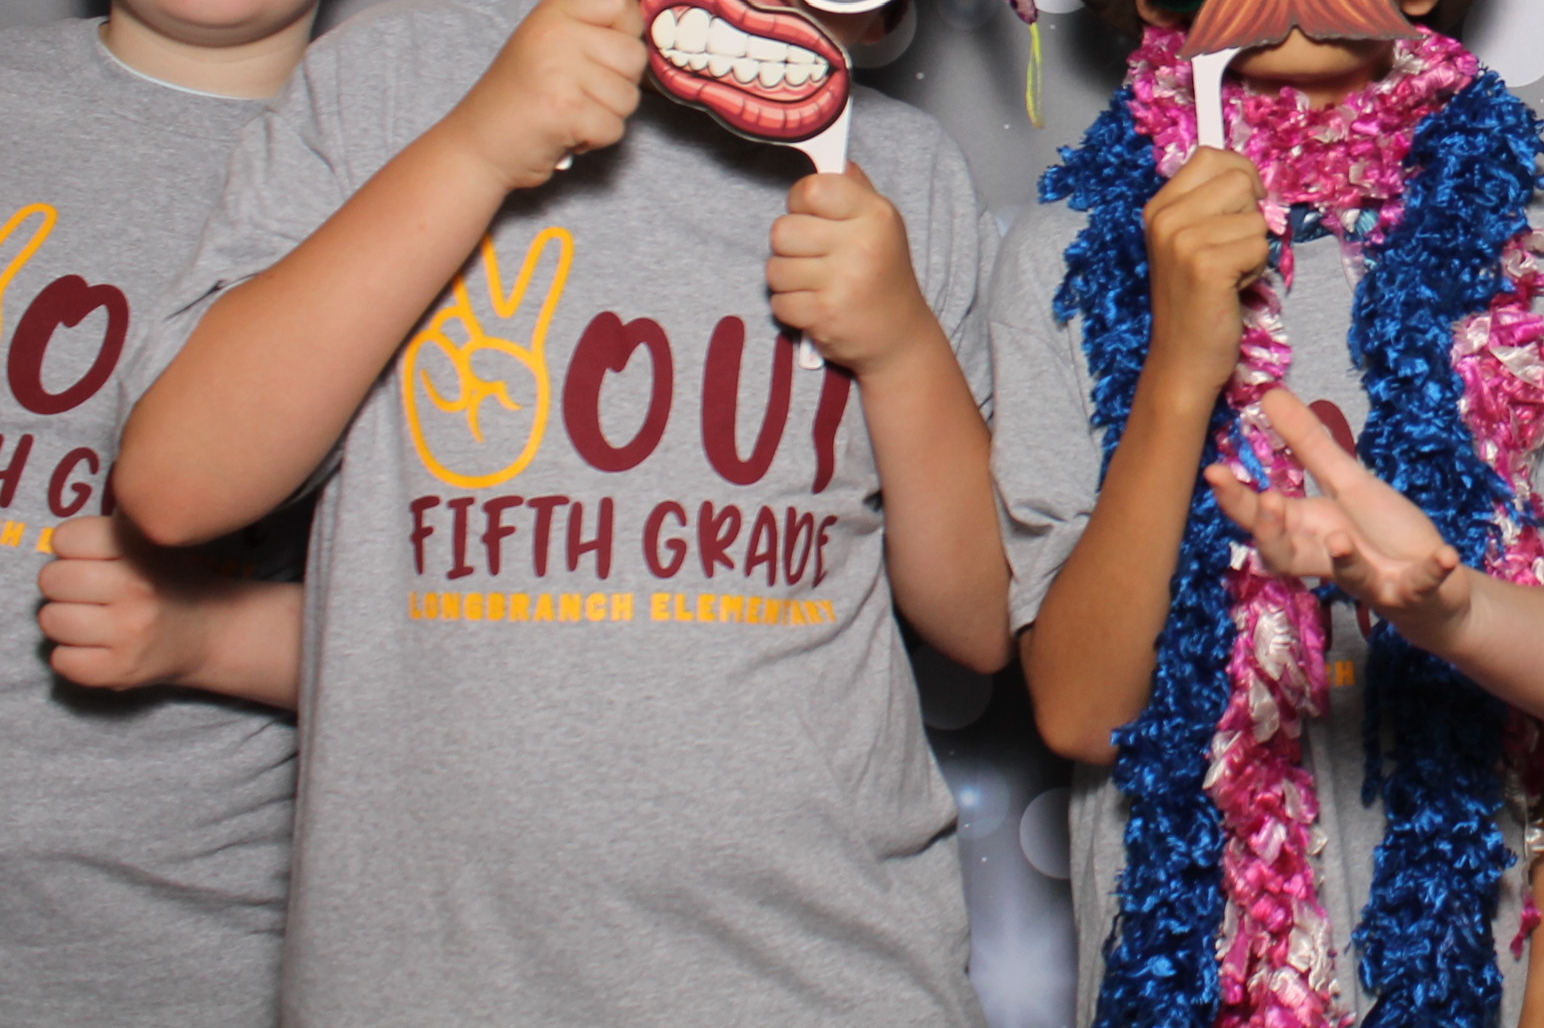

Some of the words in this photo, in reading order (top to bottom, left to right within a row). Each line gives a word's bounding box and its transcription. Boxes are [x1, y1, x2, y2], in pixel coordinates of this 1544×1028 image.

[410, 495, 614, 580] FIFTH
[642, 500, 837, 588] GRADE
[409, 592, 634, 623] LONGBRANCH
